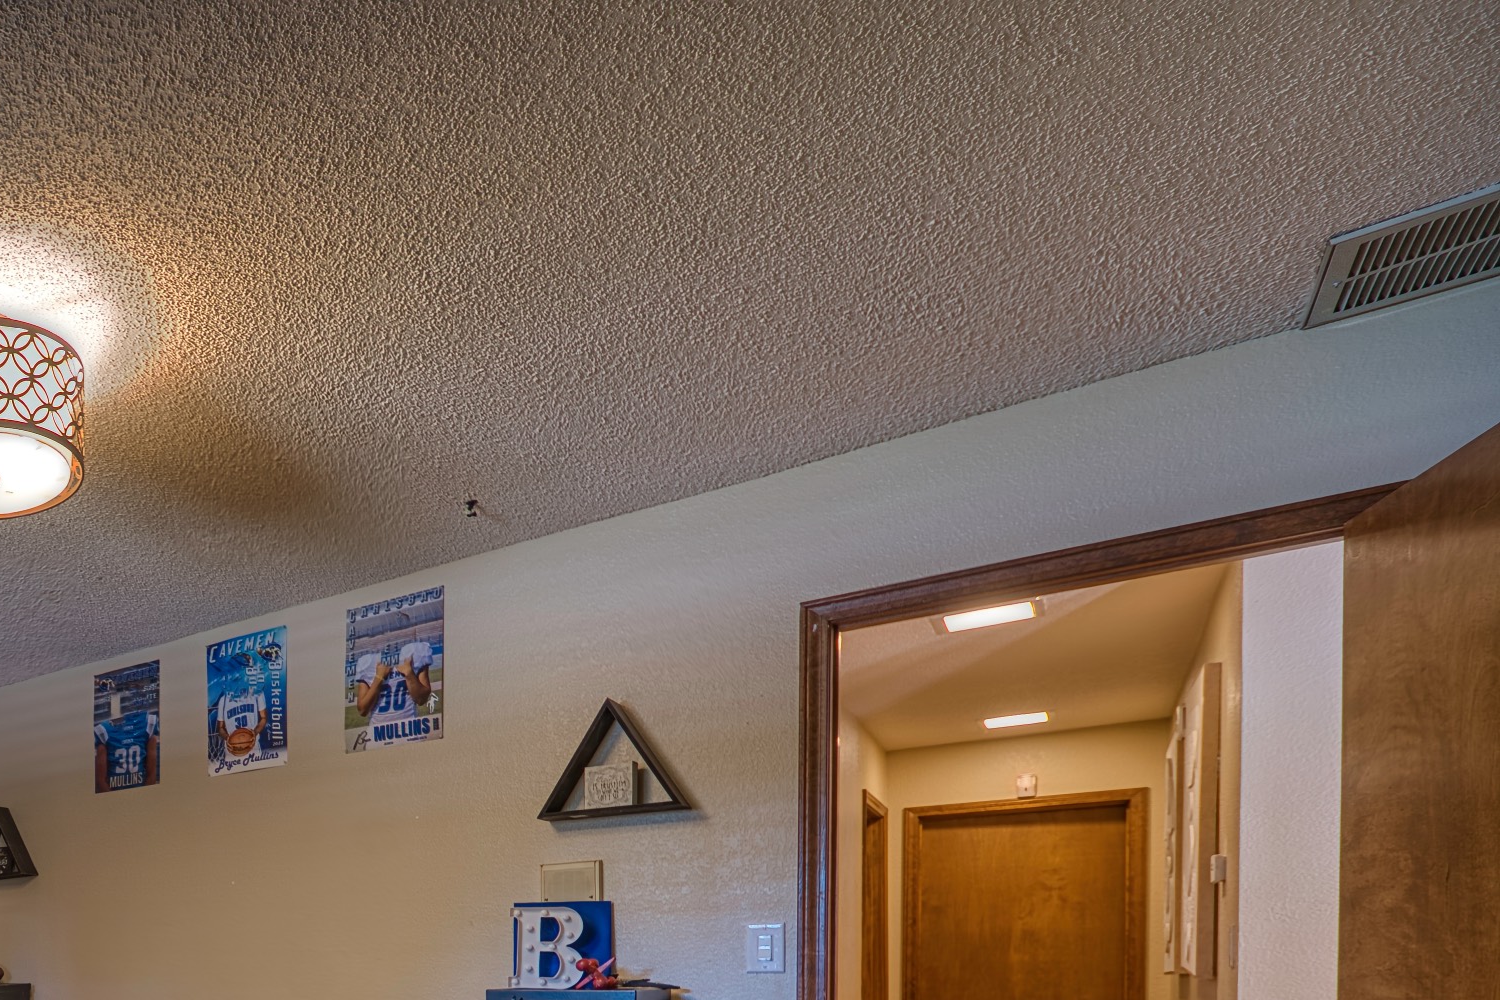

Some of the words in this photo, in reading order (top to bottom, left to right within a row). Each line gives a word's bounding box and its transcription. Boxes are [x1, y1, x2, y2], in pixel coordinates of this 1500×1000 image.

[209, 631, 276, 664] CAVEMEN
[345, 609, 356, 703] CAVEMEN
[268, 659, 284, 741] Basketball
[373, 717, 431, 743] MULLINS
[114, 745, 141, 774] 30
[214, 758, 242, 774] Bryce
[243, 750, 279, 768] Mullins
[109, 772, 143, 788] MULLINS
[508, 906, 585, 990] B
